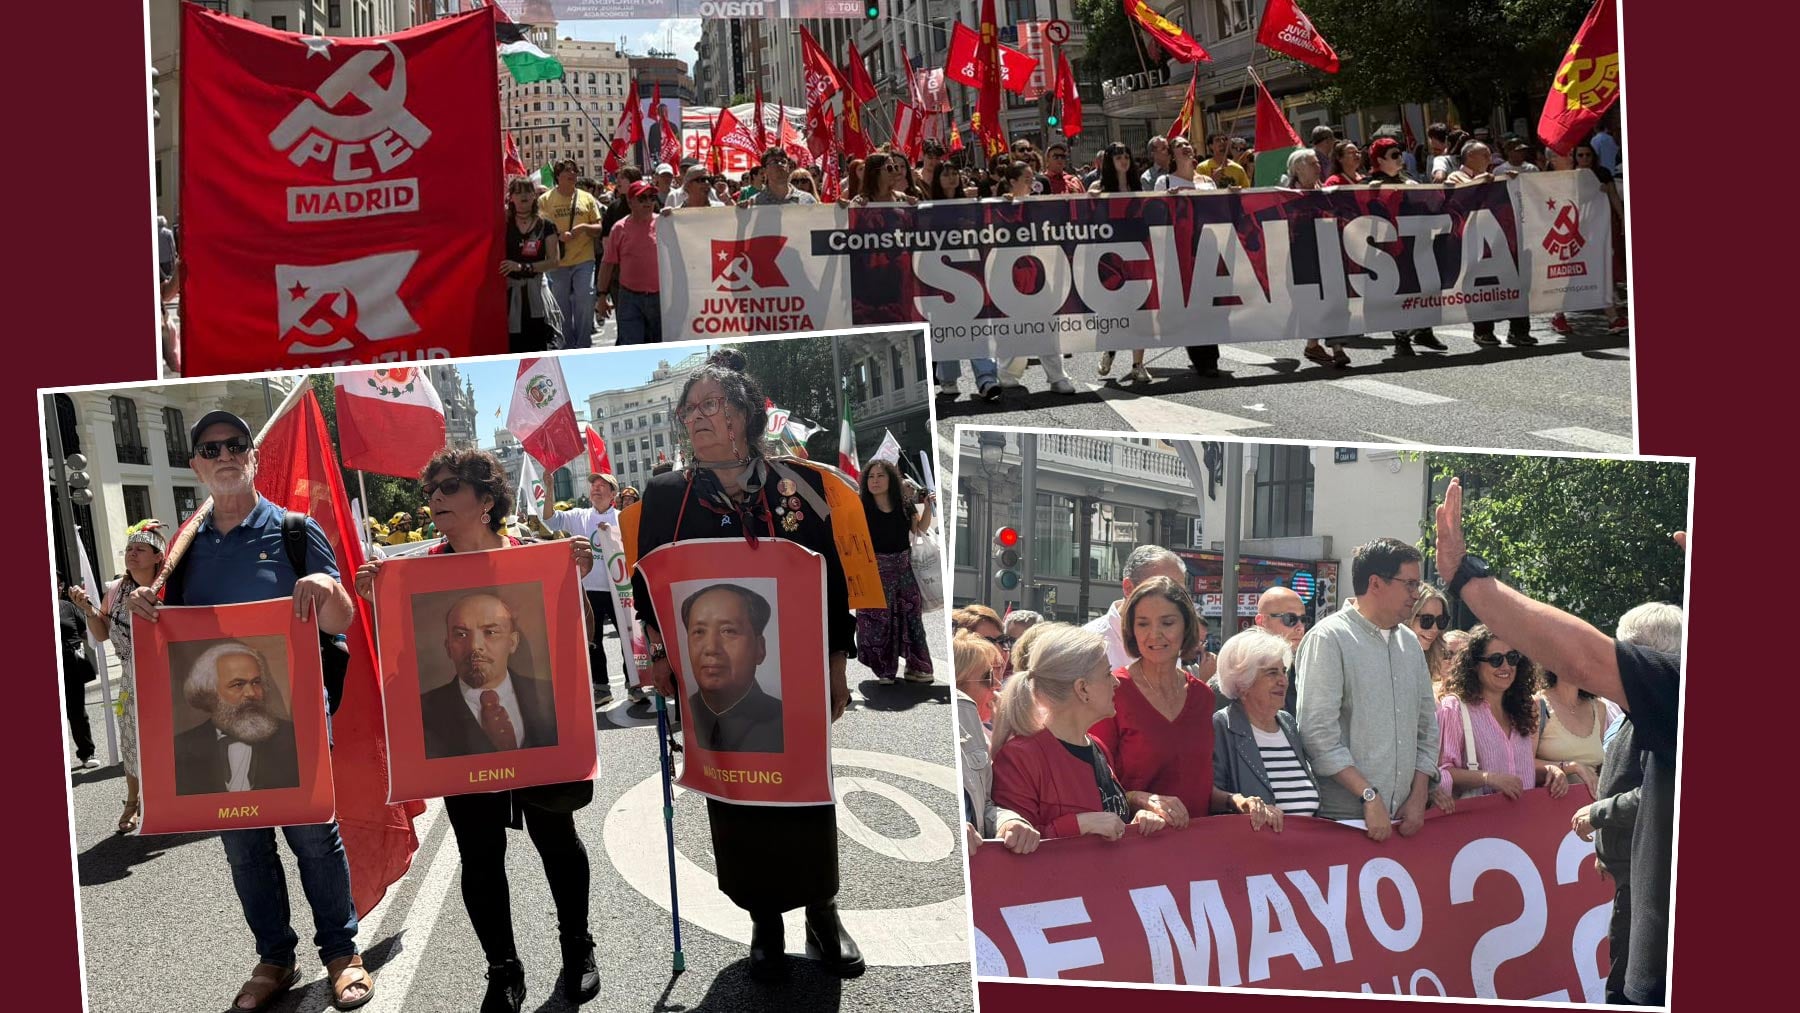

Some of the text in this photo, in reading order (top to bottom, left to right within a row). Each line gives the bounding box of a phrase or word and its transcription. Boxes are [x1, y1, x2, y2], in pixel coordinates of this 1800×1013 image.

[1115, 69, 1169, 95] HOTEL
[289, 131, 414, 182] PCE
[295, 185, 414, 216] MADRID
[828, 220, 1114, 252] Construyendo el futuro
[1547, 238, 1582, 262] PCE
[913, 208, 1521, 319] SOCIALISTA
[1549, 264, 1583, 278] MADRID
[700, 296, 806, 316] JUVENTUD
[1401, 287, 1521, 311] #FuturoSocialista
[692, 314, 815, 334] COMUNISTA
[930, 315, 1130, 344] igno para una vida digna
[1206, 595, 1245, 605] PHE
[468, 766, 516, 784] LENIN
[217, 804, 260, 820] MARX
[1129, 857, 1423, 987] MAYO
